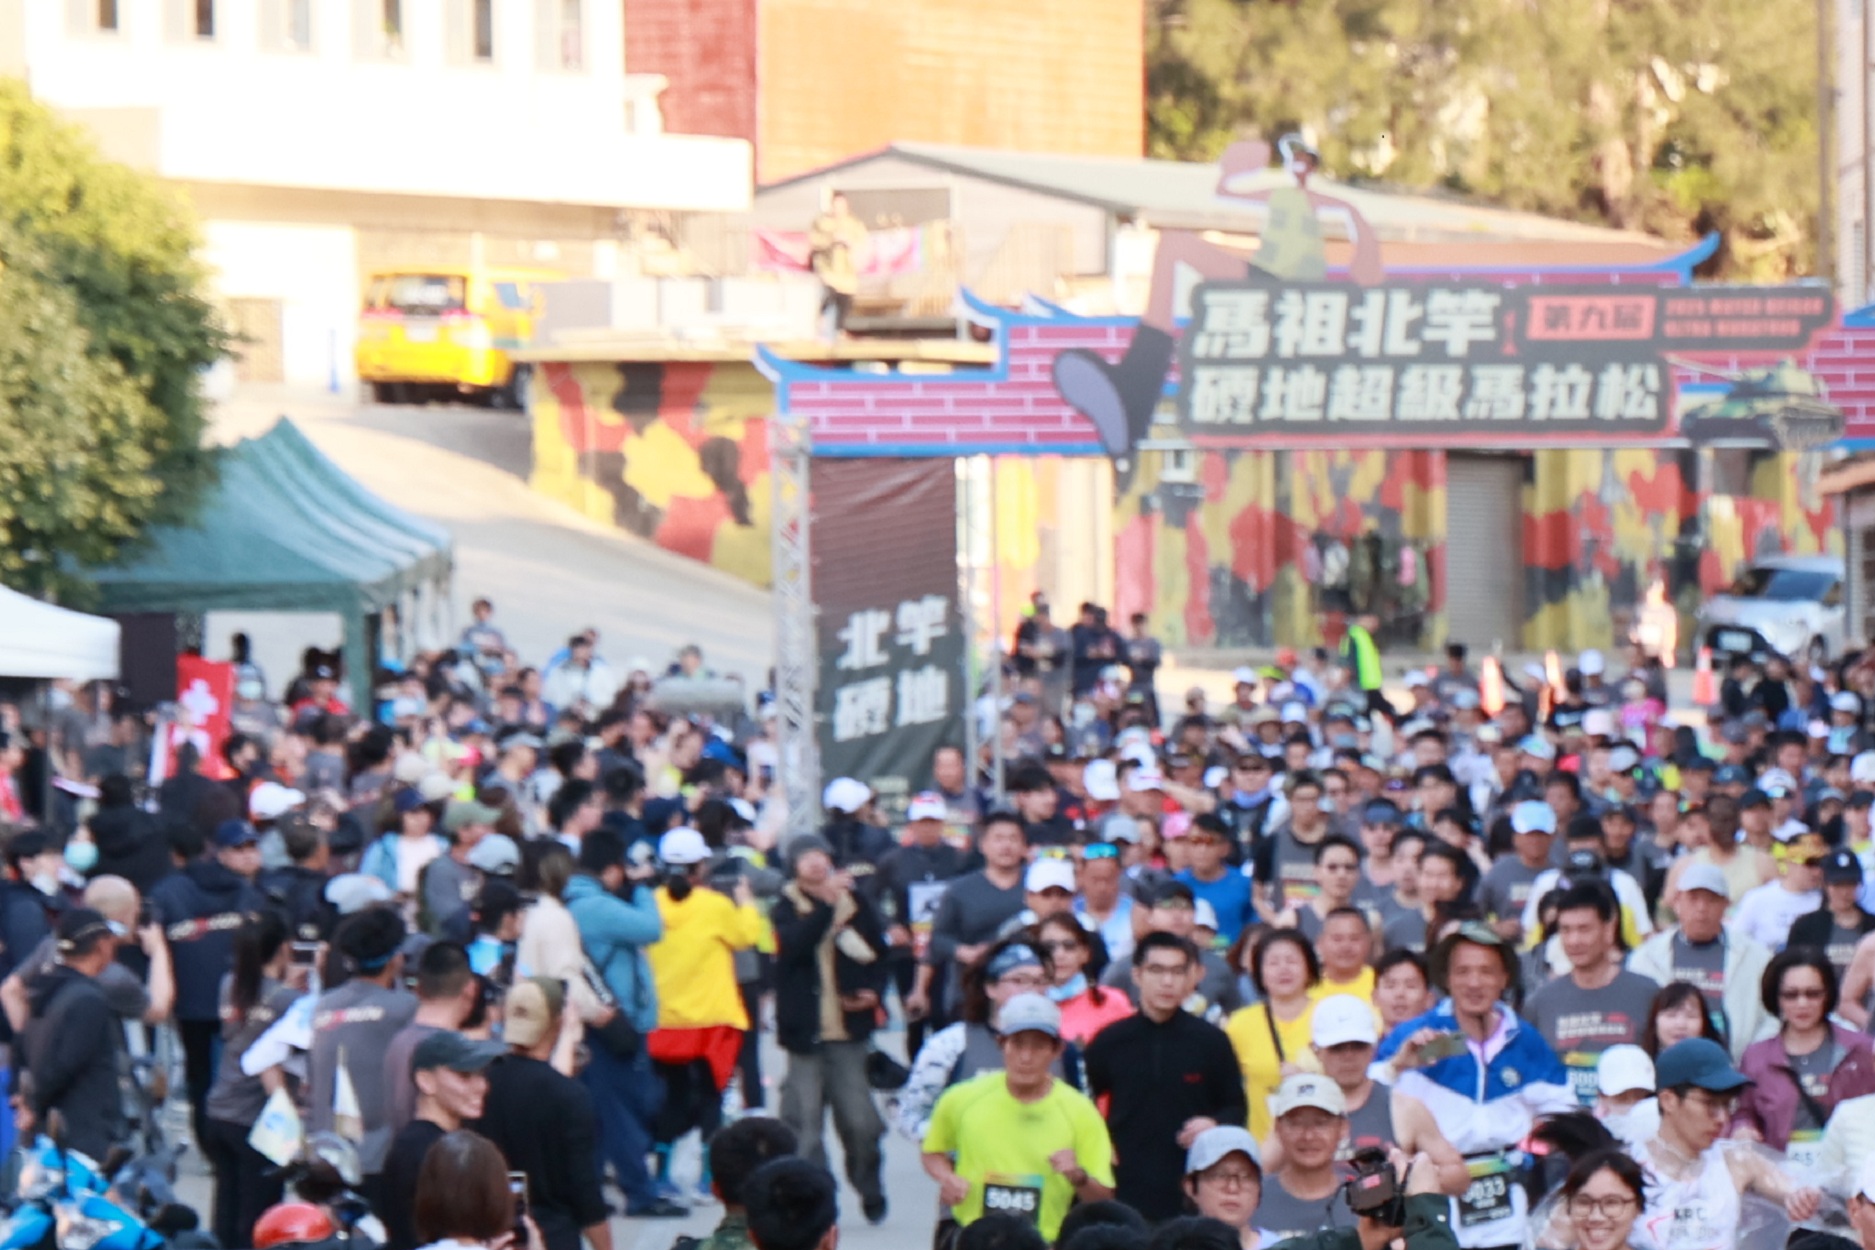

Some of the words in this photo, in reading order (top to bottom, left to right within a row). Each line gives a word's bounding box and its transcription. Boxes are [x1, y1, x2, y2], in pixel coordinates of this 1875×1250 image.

[1192, 288, 1501, 357] 馬祖北竿
[1189, 363, 1661, 423] 硬地超級馬拉松
[836, 593, 949, 671] 北竿
[834, 669, 949, 742] 硬地
[986, 1187, 1036, 1212] 5045
